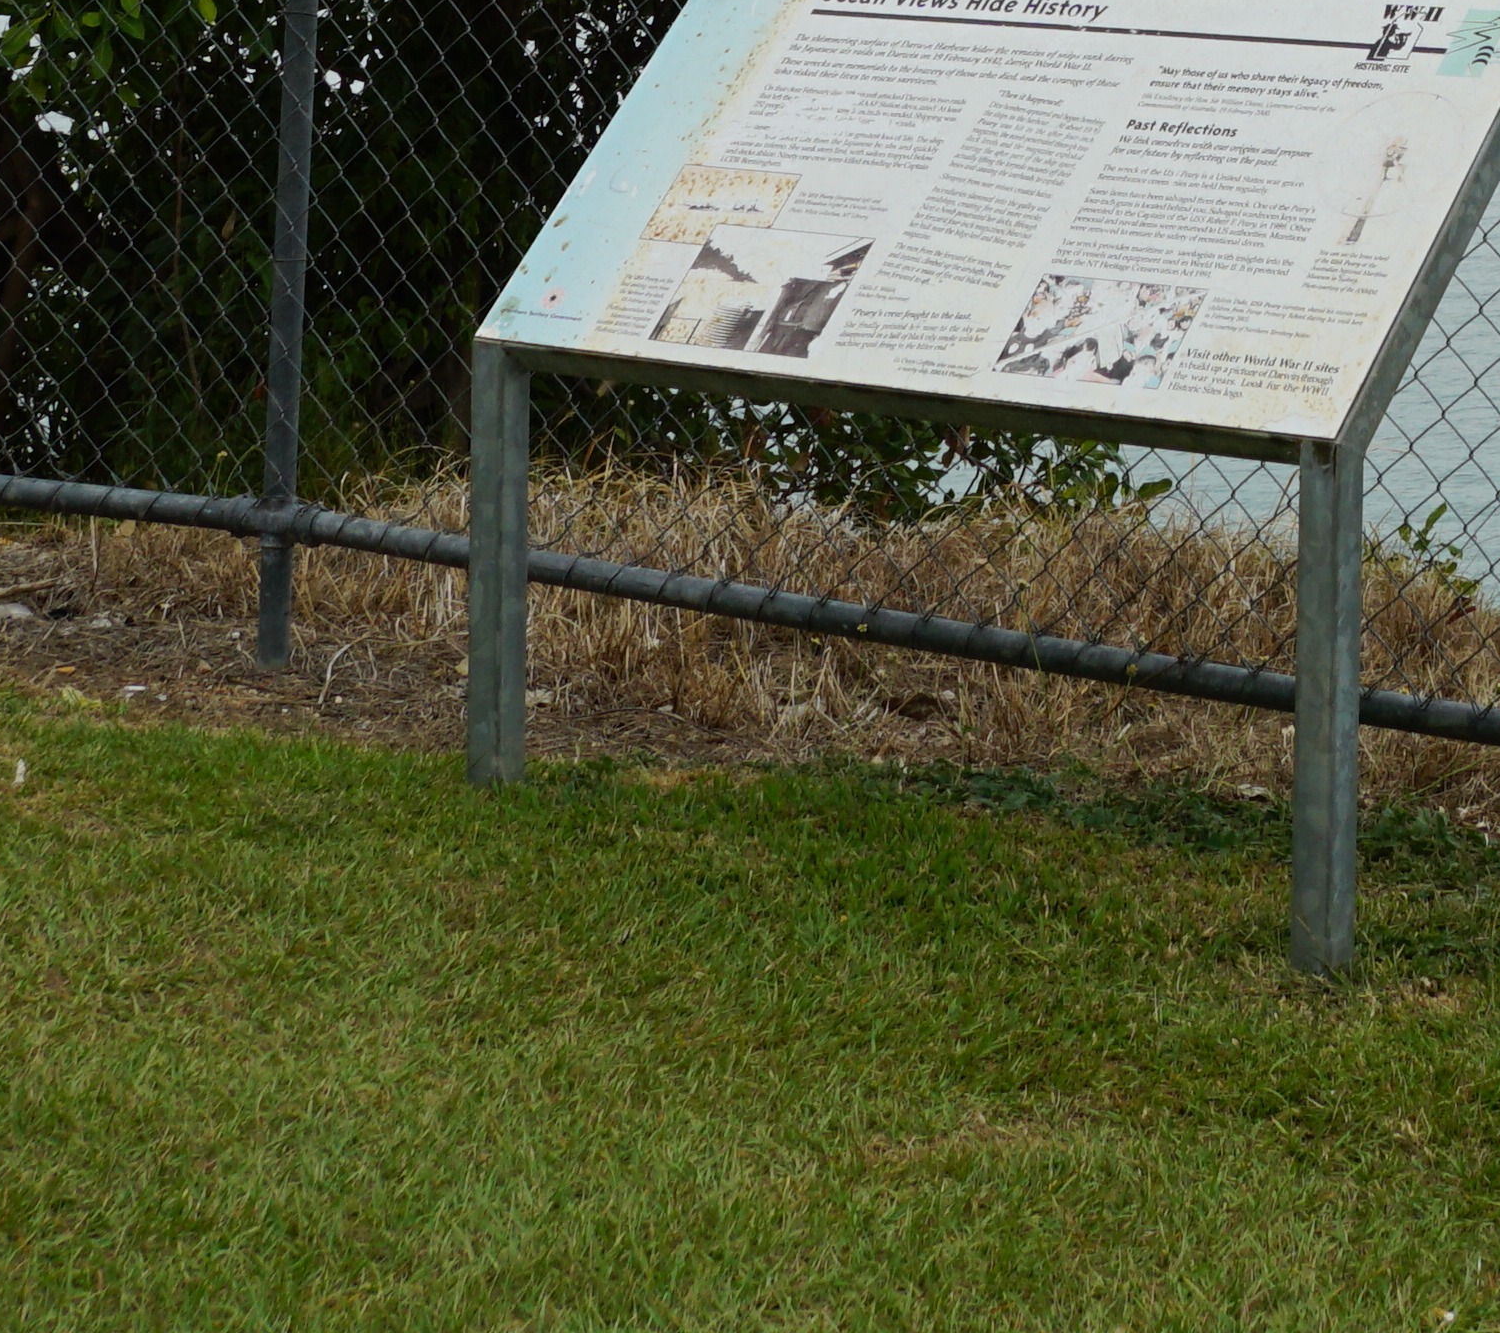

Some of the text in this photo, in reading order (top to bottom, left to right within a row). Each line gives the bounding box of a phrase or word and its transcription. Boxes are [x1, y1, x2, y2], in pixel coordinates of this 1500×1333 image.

[1353, 62, 1410, 73] HISTORIC SITE
[1181, 67, 1205, 77] those
[1206, 69, 1218, 80] of
[1230, 71, 1250, 80] who
[1250, 72, 1276, 82] share
[1277, 73, 1299, 83] their
[1299, 75, 1330, 88] legacy
[1331, 77, 1343, 88] of
[1341, 78, 1383, 90] freedom,
[1149, 80, 1180, 88] ensure
[1182, 80, 1201, 89] that
[1203, 81, 1225, 91] their
[1226, 85, 1266, 96] memory
[1266, 87, 1292, 97] stays
[1126, 119, 1237, 137] Past Reflections
[1186, 348, 1339, 373] Visit other World War II sites
[1208, 376, 1235, 386] years.
[1240, 378, 1263, 388] Look
[1301, 384, 1329, 395] WWII
